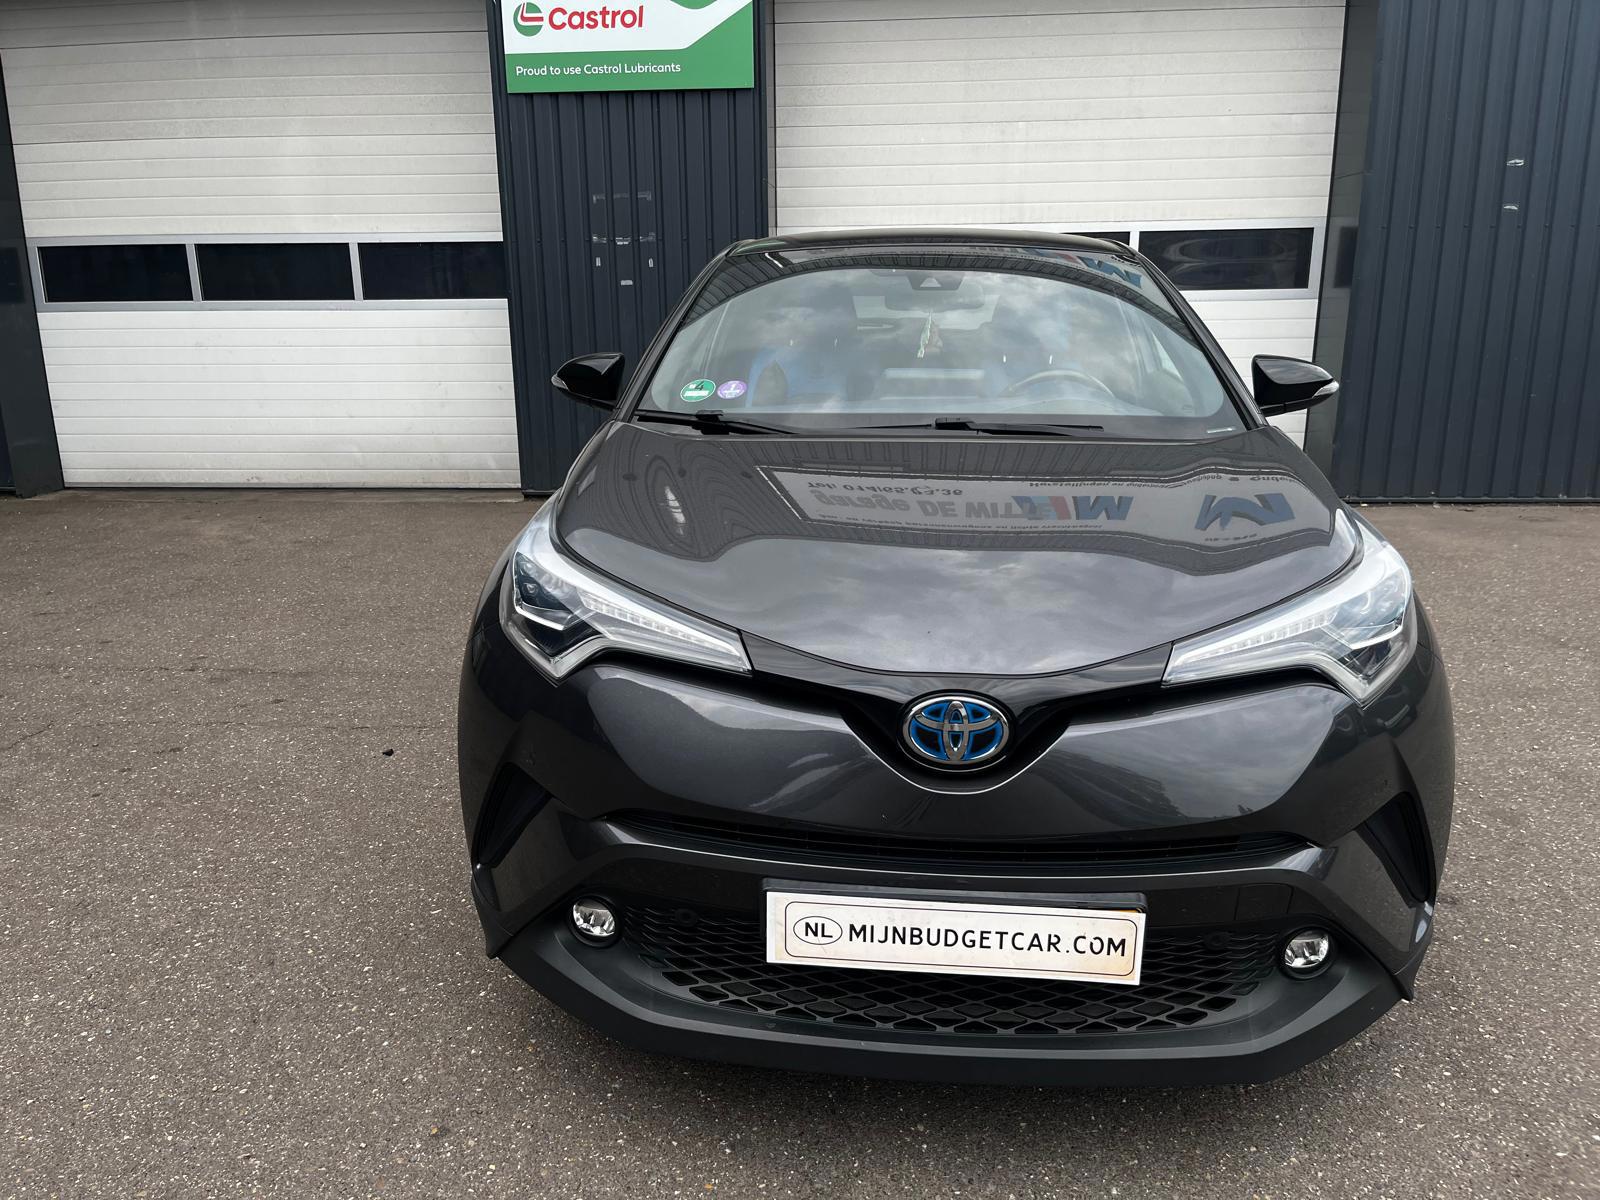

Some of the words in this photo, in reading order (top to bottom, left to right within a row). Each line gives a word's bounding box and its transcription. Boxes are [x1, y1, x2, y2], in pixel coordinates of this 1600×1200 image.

[548, 5, 644, 31] Castrol
[515, 65, 547, 77] Proud
[550, 66, 561, 76] to
[563, 66, 582, 76] use
[583, 63, 622, 75] Castrol
[624, 62, 681, 74] Lubricants
[803, 921, 833, 939] NL
[848, 923, 1127, 957] MIJNBUDGETCAR.COM
